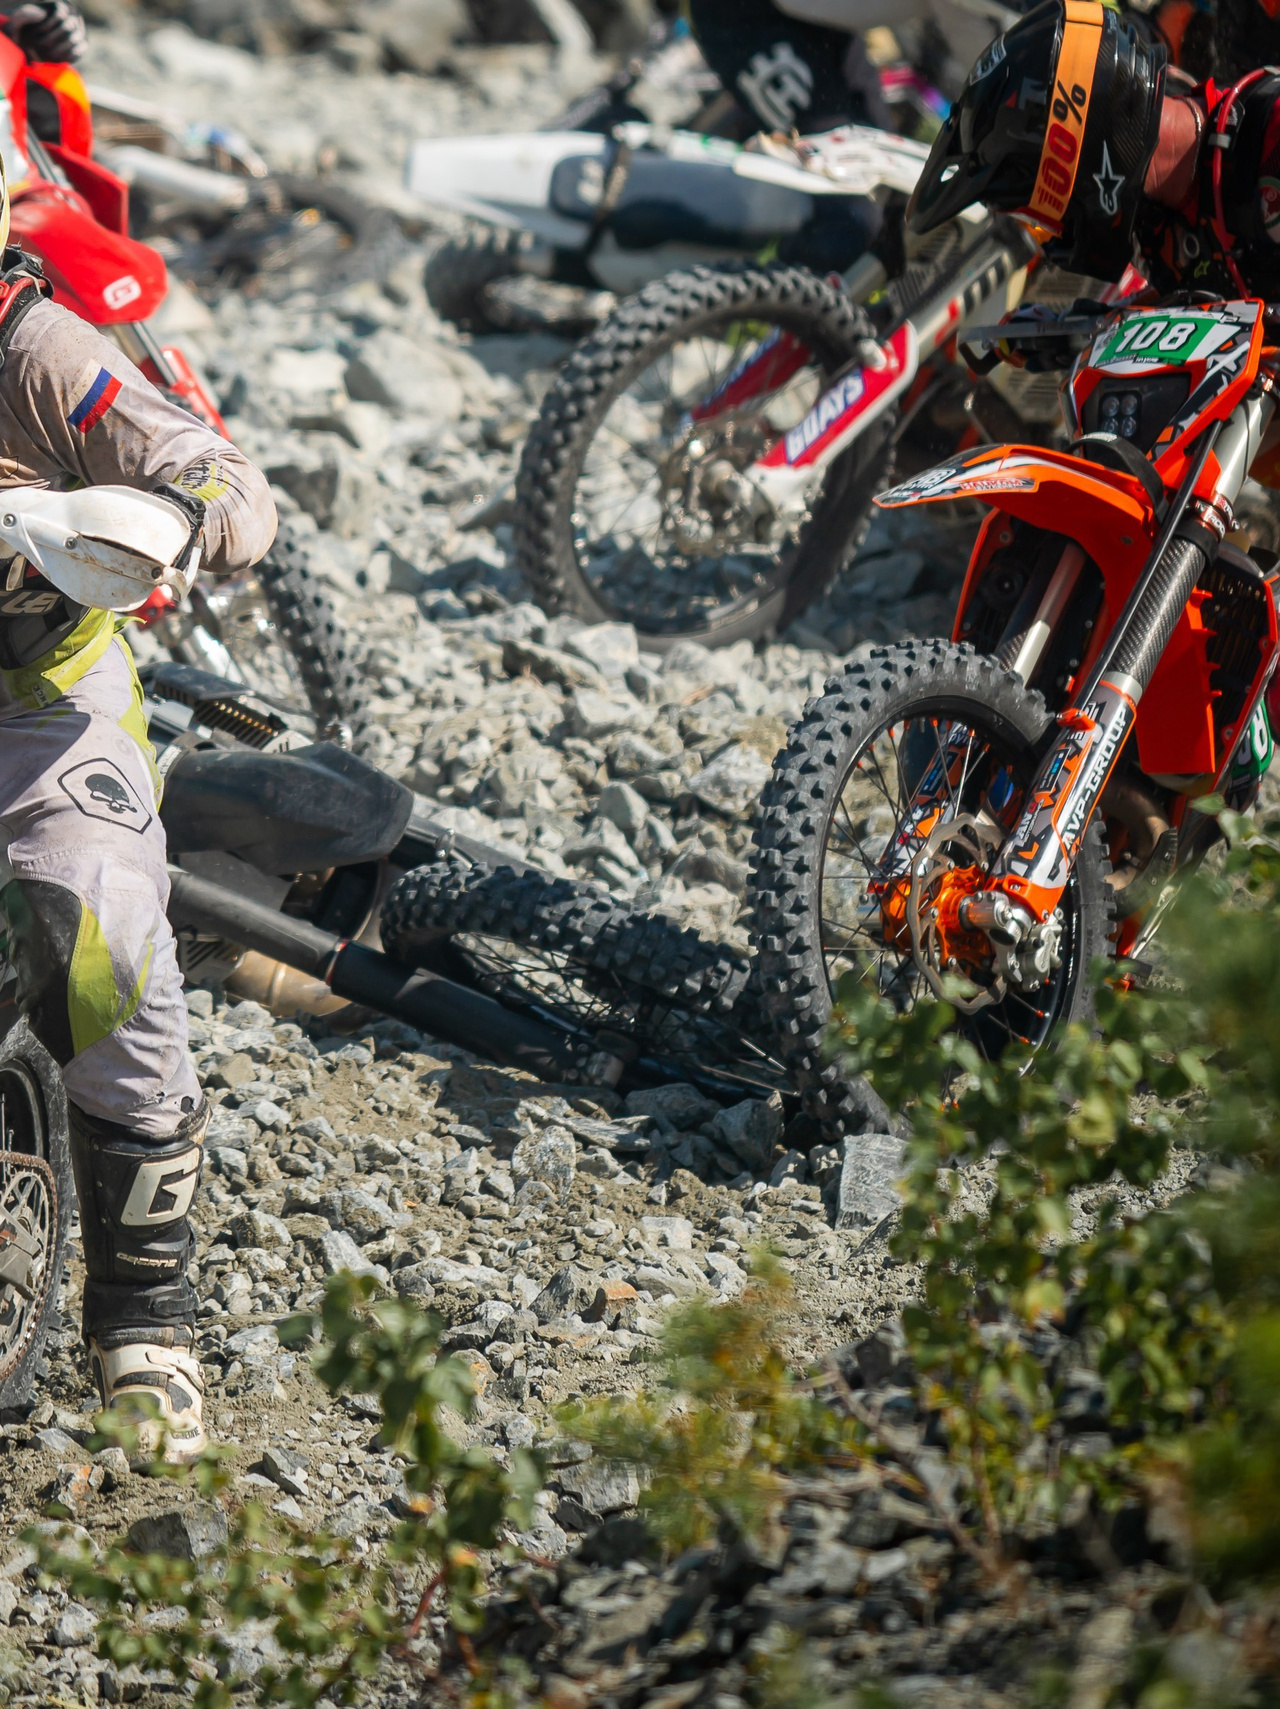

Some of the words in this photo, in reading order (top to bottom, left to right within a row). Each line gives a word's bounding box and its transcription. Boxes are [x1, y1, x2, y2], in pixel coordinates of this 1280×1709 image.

[1038, 80, 1087, 214] 100%
[1115, 321, 1196, 353] 108
[1061, 706, 1127, 850] AVP-GROUP
